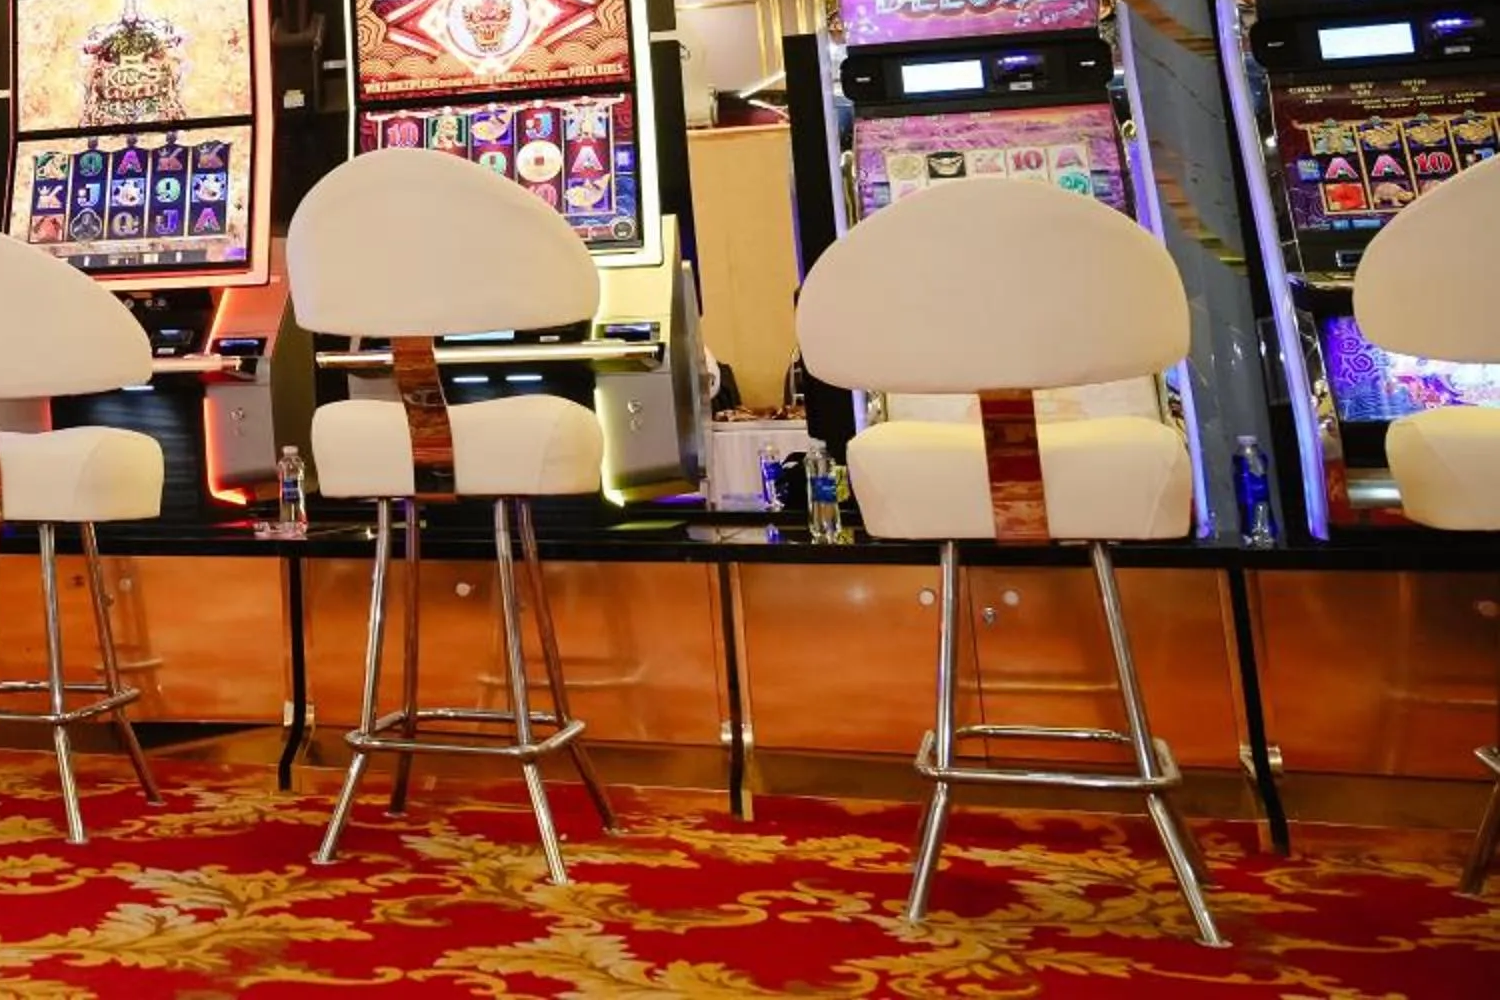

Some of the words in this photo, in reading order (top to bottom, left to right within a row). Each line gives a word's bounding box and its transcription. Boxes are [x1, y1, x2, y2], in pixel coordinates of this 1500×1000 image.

[387, 121, 419, 148] 10
[526, 112, 552, 139] J
[79, 152, 103, 177] 9
[117, 150, 142, 175] A
[158, 147, 183, 171] K
[197, 143, 224, 169] K
[571, 146, 603, 172] A
[1011, 151, 1043, 170] 10
[1056, 150, 1084, 168] A
[1325, 157, 1358, 178] A
[1371, 155, 1405, 176] A
[1415, 151, 1453, 173] 10
[37, 185, 63, 209] K
[77, 183, 100, 207] J
[155, 177, 181, 203] 9
[112, 212, 140, 236] Q
[155, 209, 179, 235] J
[194, 207, 221, 233] A
